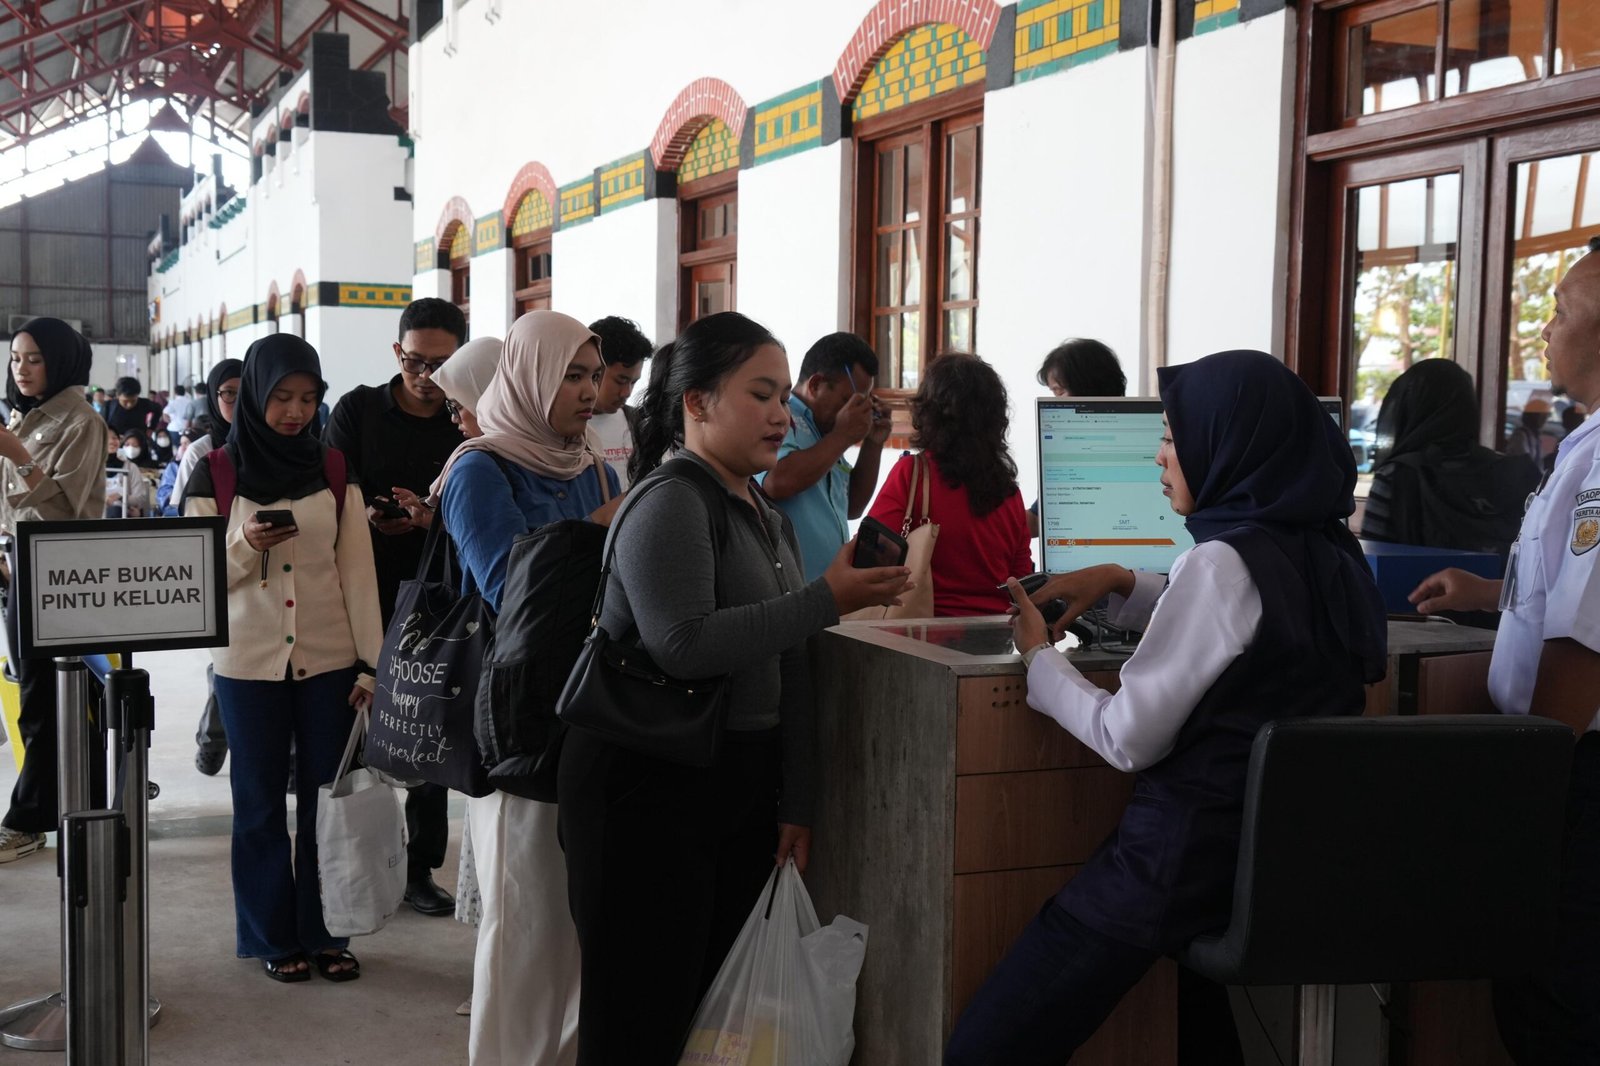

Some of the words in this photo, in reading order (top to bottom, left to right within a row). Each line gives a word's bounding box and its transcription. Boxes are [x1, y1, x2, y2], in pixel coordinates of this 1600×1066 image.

[48, 568, 111, 586] MAAF
[117, 565, 193, 583] BUKAN
[41, 591, 106, 610] PINTU
[113, 587, 202, 606] KELUAR
[379, 710, 444, 737] PERFECTLY
[372, 734, 453, 772] imperfect
